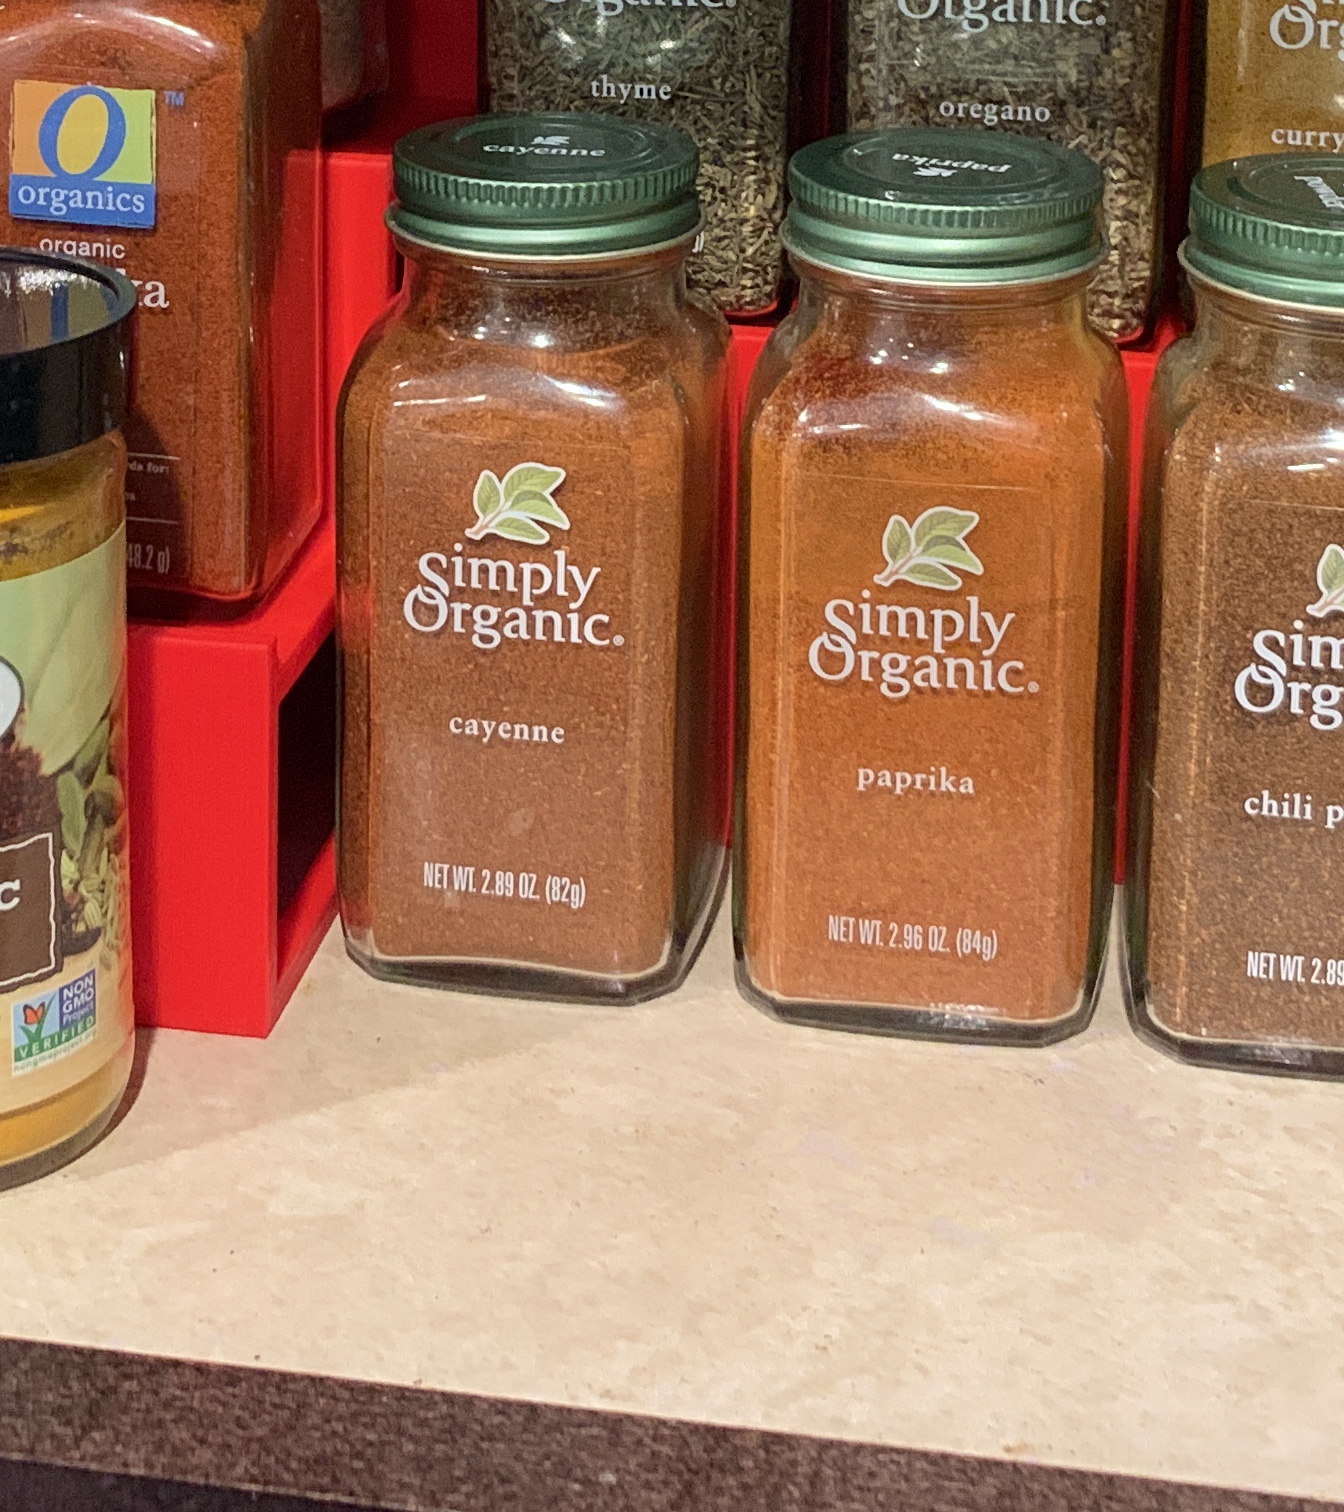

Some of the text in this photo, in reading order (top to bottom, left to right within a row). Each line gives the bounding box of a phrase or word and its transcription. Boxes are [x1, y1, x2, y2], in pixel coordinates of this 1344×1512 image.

[591, 75, 672, 103] thyme
[939, 101, 1051, 125] oregano
[483, 143, 605, 157] cayenne
[18, 186, 145, 215] organics
[40, 238, 126, 259] organic
[418, 543, 601, 610] Simply
[403, 585, 611, 649] Organic
[824, 589, 1016, 656] Simply
[808, 631, 1025, 698] Organic
[449, 716, 565, 744] cayenne
[857, 766, 975, 795] paprika
[1243, 790, 1313, 820] chili
[423, 862, 586, 909] NET WT. 2.89 OZ. (82g)
[828, 915, 998, 961] NET WT. 2.96 OZ. (84g)
[1247, 951, 1276, 980] NET
[1280, 954, 1305, 983] WT.
[62, 988, 94, 1014] GMO
[63, 974, 93, 1001] NON
[63, 1001, 93, 1025] Project
[19, 1016, 93, 1058] VERIFIED
